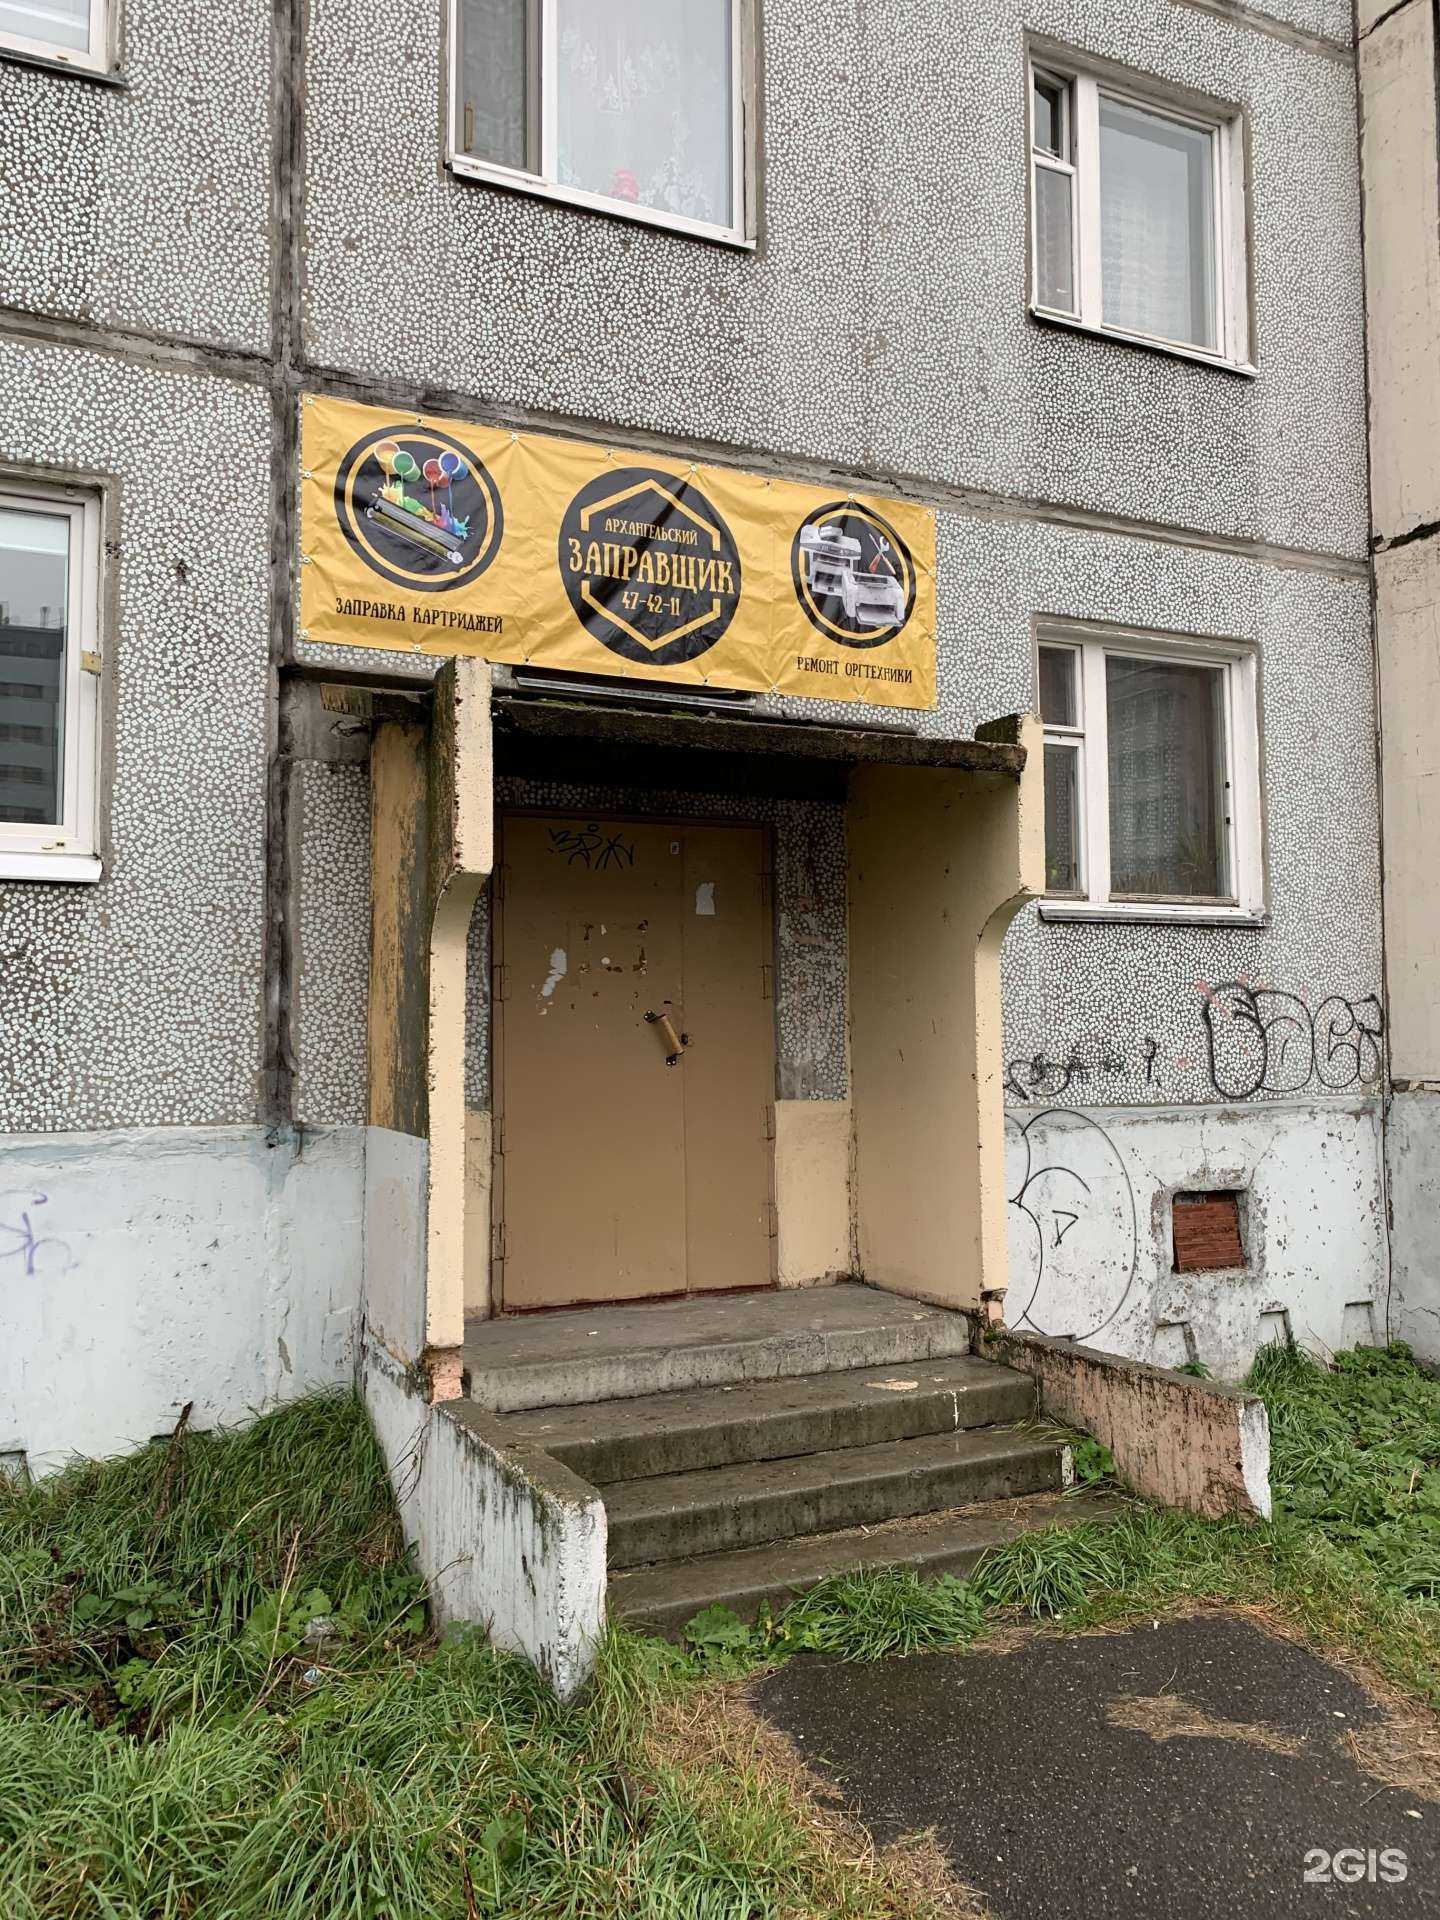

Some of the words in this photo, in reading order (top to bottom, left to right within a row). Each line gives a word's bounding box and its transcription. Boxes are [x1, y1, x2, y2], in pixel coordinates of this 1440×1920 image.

[605, 517, 698, 546] АРХАНГЕЛЬСКИЙ
[568, 538, 735, 594] ЗАПРАВЩИК
[336, 597, 406, 622] ЗАПРАВКА
[412, 606, 503, 634] КАРТРИДЖЕЙ
[622, 591, 680, 616] 47-42-11
[797, 656, 839, 675] РЕМОНТ
[845, 662, 912, 684] ОРГТЕХНИКИ
